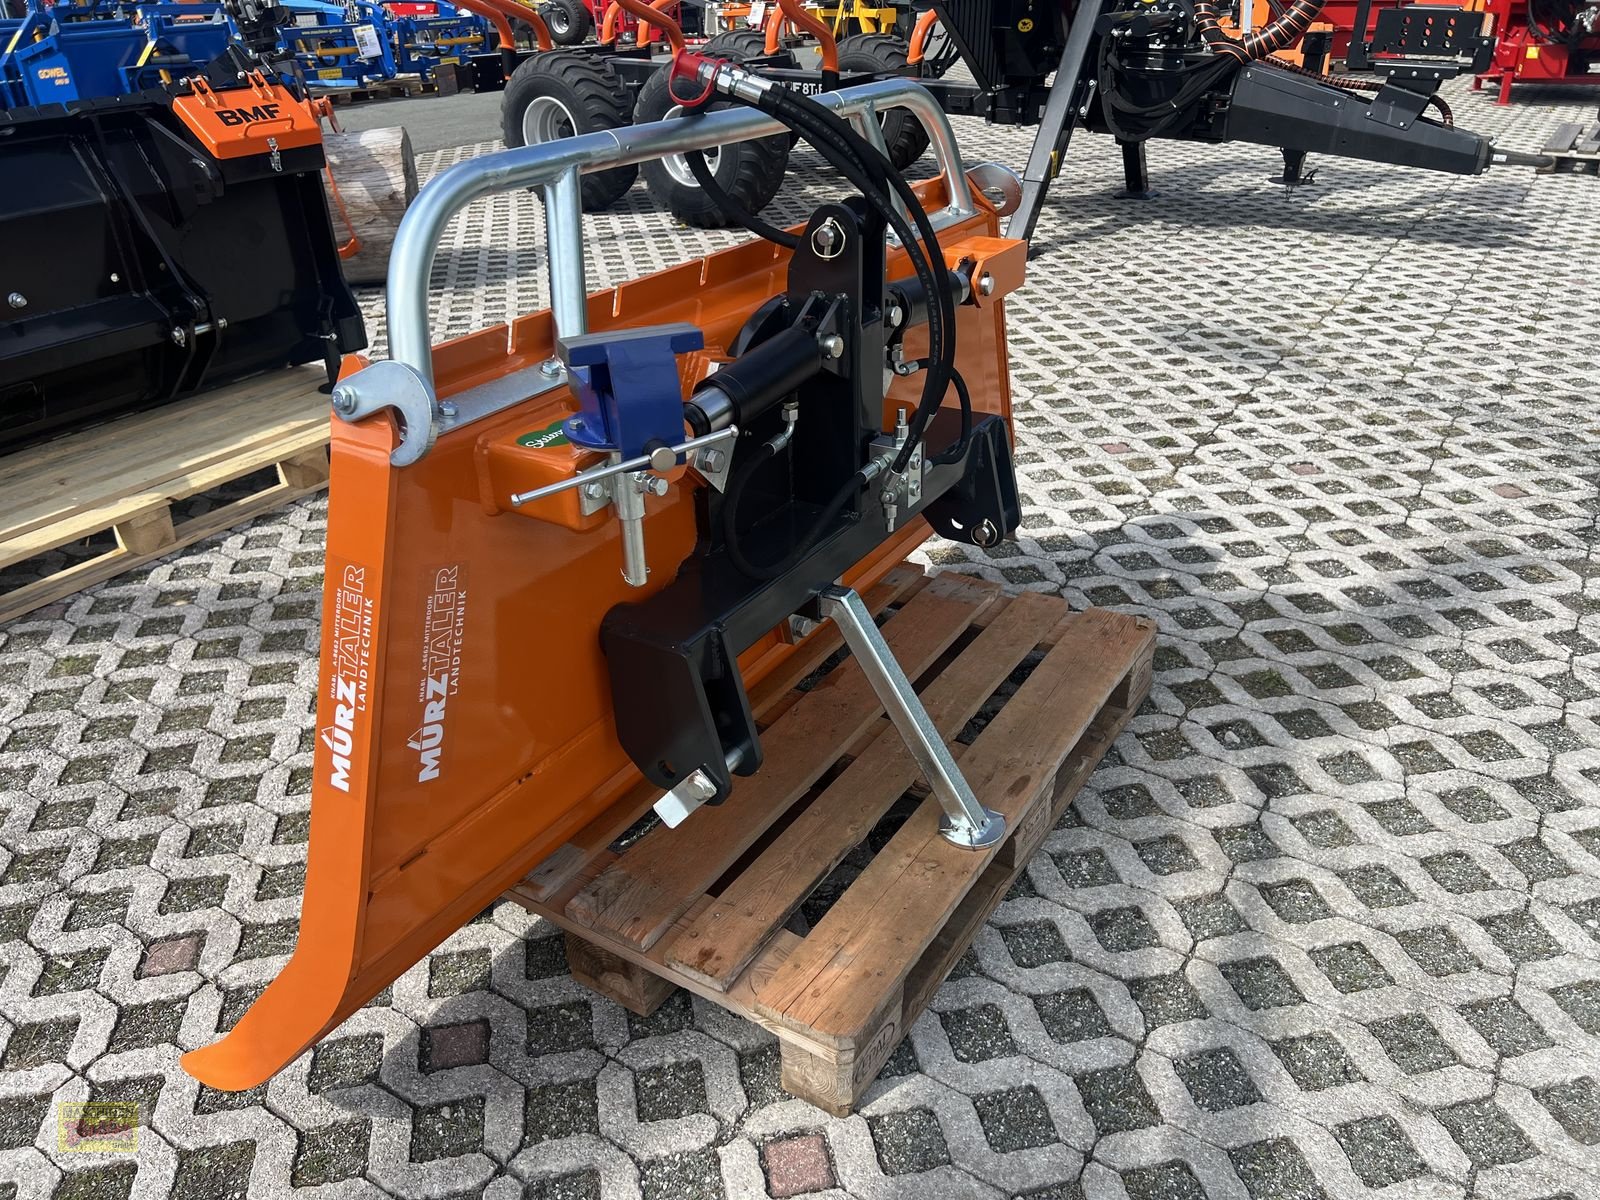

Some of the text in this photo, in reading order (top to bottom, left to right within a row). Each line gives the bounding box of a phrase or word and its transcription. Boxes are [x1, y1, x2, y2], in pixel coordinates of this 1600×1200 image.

[214, 103, 280, 126] BMF
[334, 588, 342, 639] MITTERDORF
[419, 677, 427, 703] KNABL
[423, 595, 433, 644] MITTERDORF
[450, 590, 467, 696] LANDTECHNIK
[332, 640, 340, 667] A-8662
[357, 597, 373, 711] LANDTECHNIK
